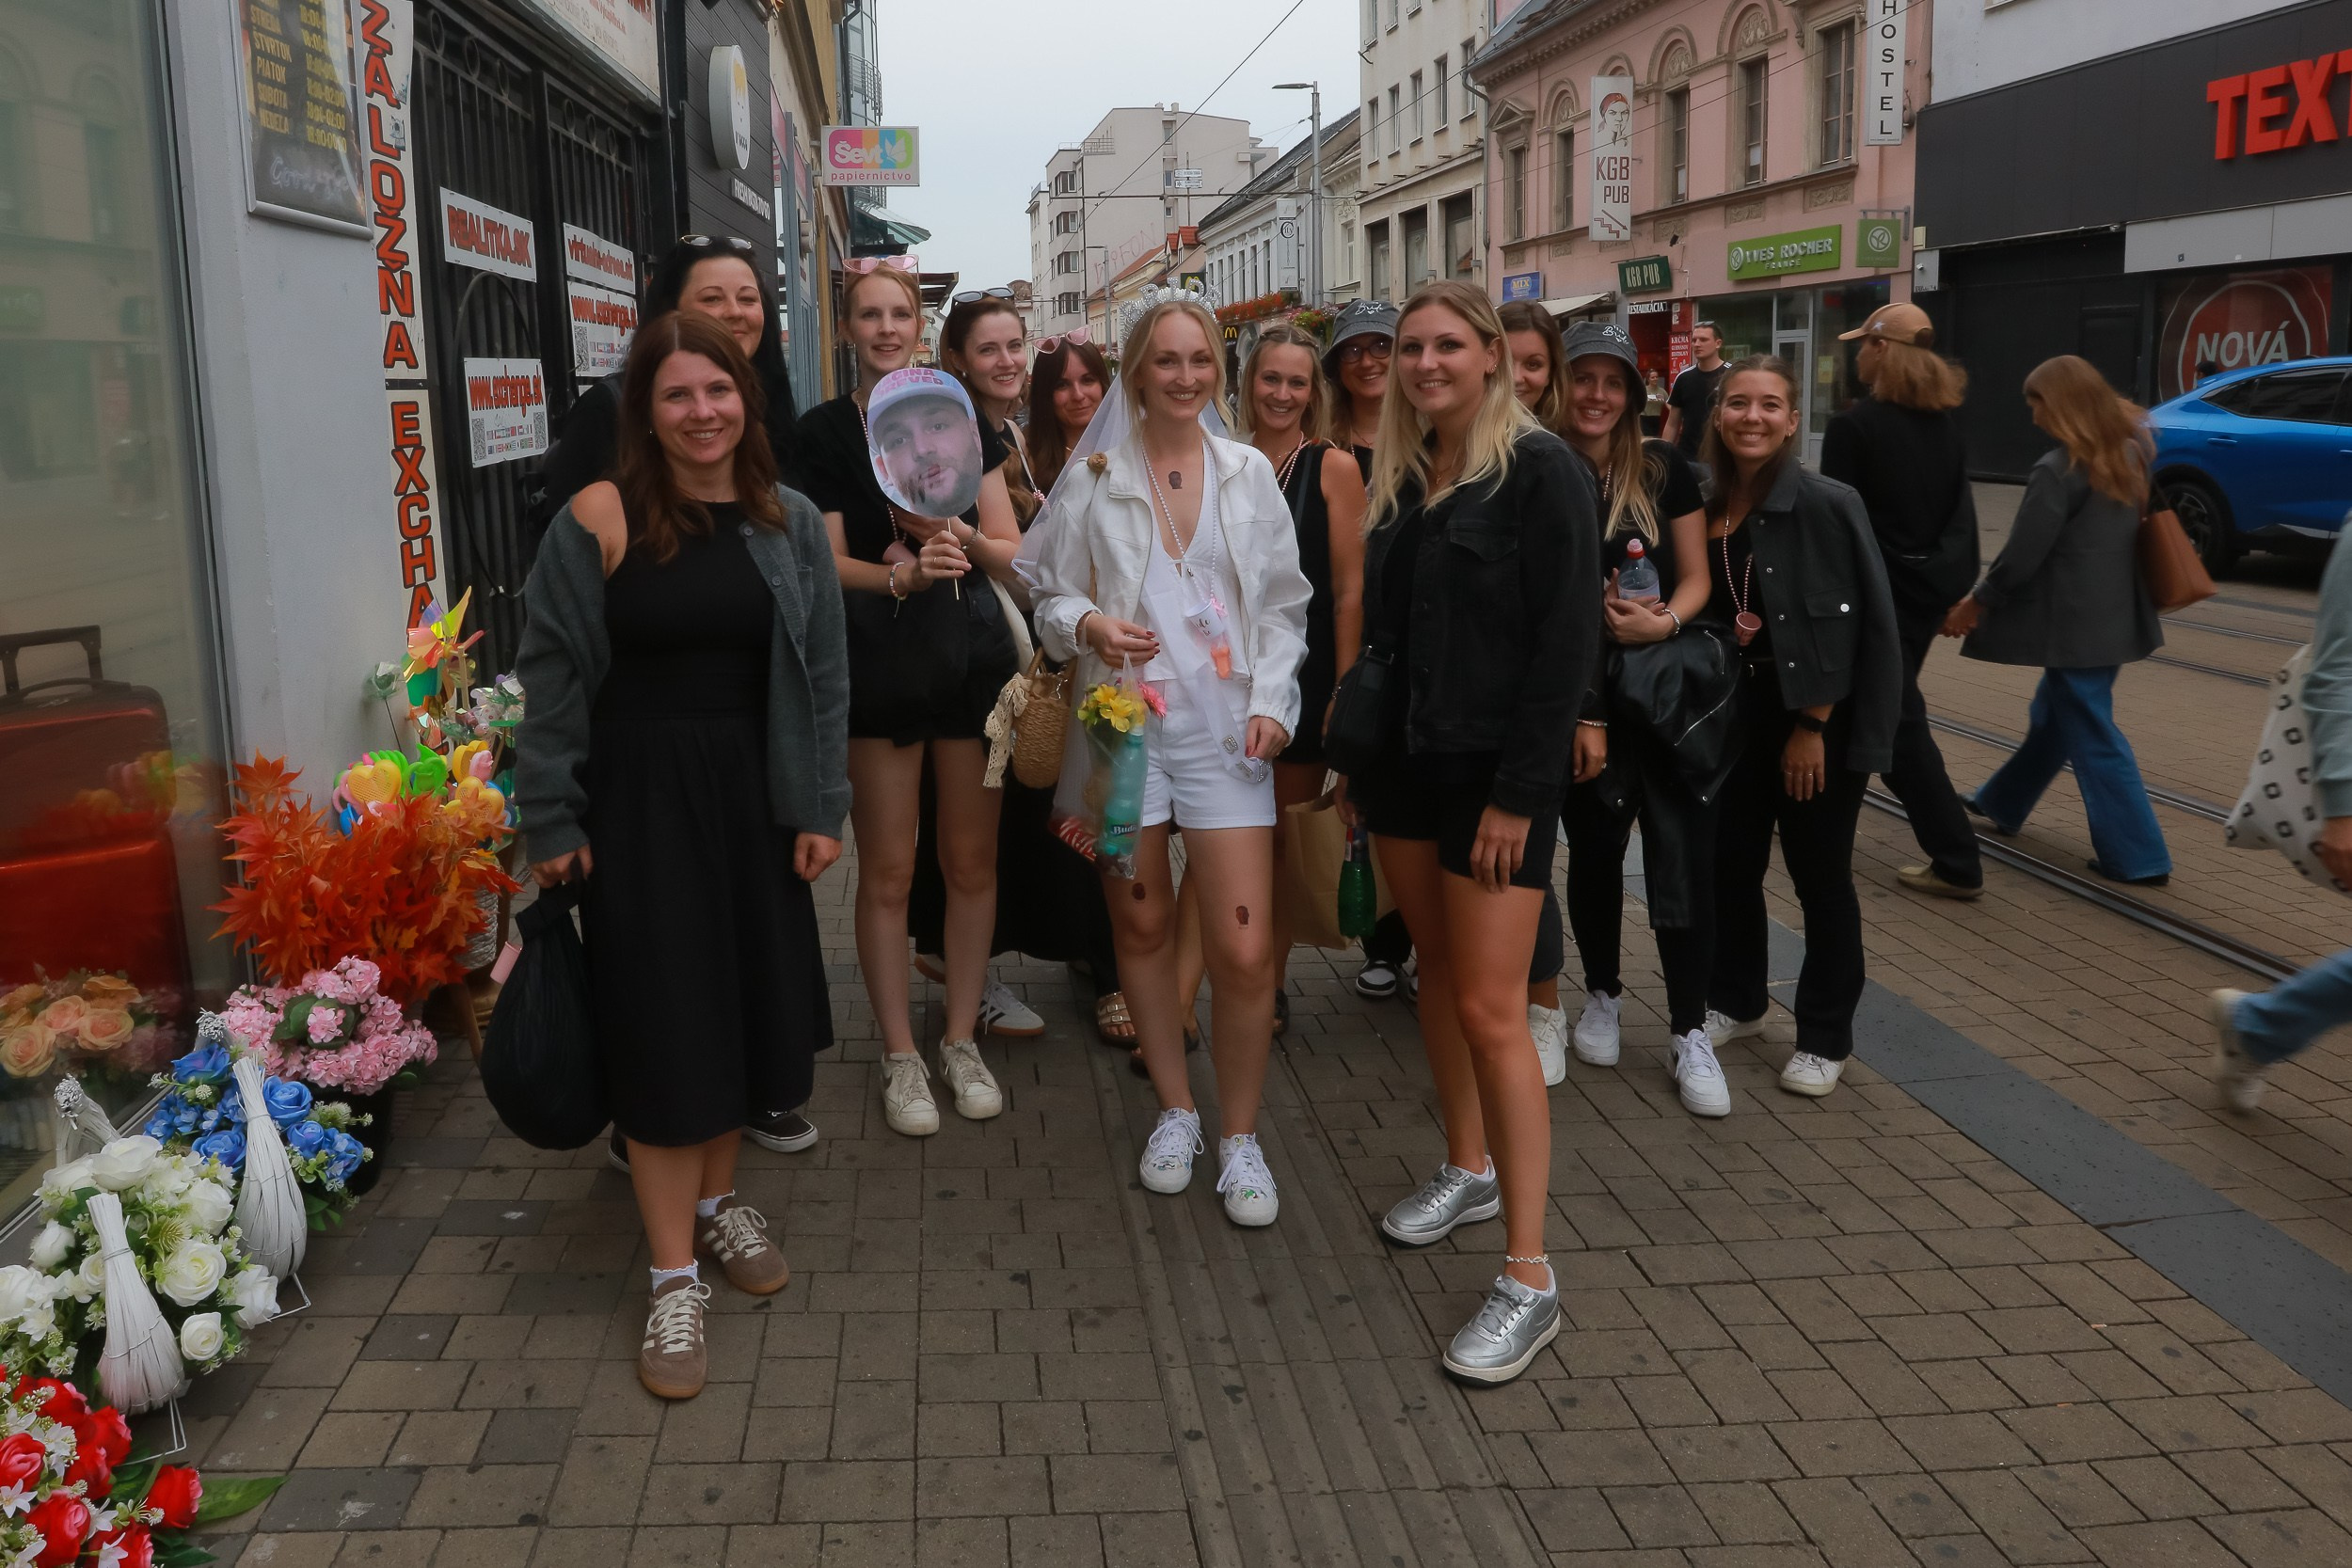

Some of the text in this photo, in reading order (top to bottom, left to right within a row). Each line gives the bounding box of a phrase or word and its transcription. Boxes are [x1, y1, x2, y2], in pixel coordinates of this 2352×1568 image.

[252, 27, 293, 62] ŠTVRTOK
[256, 55, 287, 84] PIATOK
[1880, 0, 1897, 135] HOSTEL
[835, 140, 883, 165] Ševt
[831, 171, 912, 182] papiernictvo
[1596, 156, 1629, 181] KGB
[1603, 185, 1629, 204] PUB
[446, 204, 532, 269] REALITKA.SK
[1745, 238, 1833, 263] YVES ROCHER
[1626, 262, 1661, 288] KGB PUB
[1765, 259, 1802, 270] FRANCE
[2194, 320, 2291, 369] NOVÁ
[390, 401, 437, 636] EXCHA
